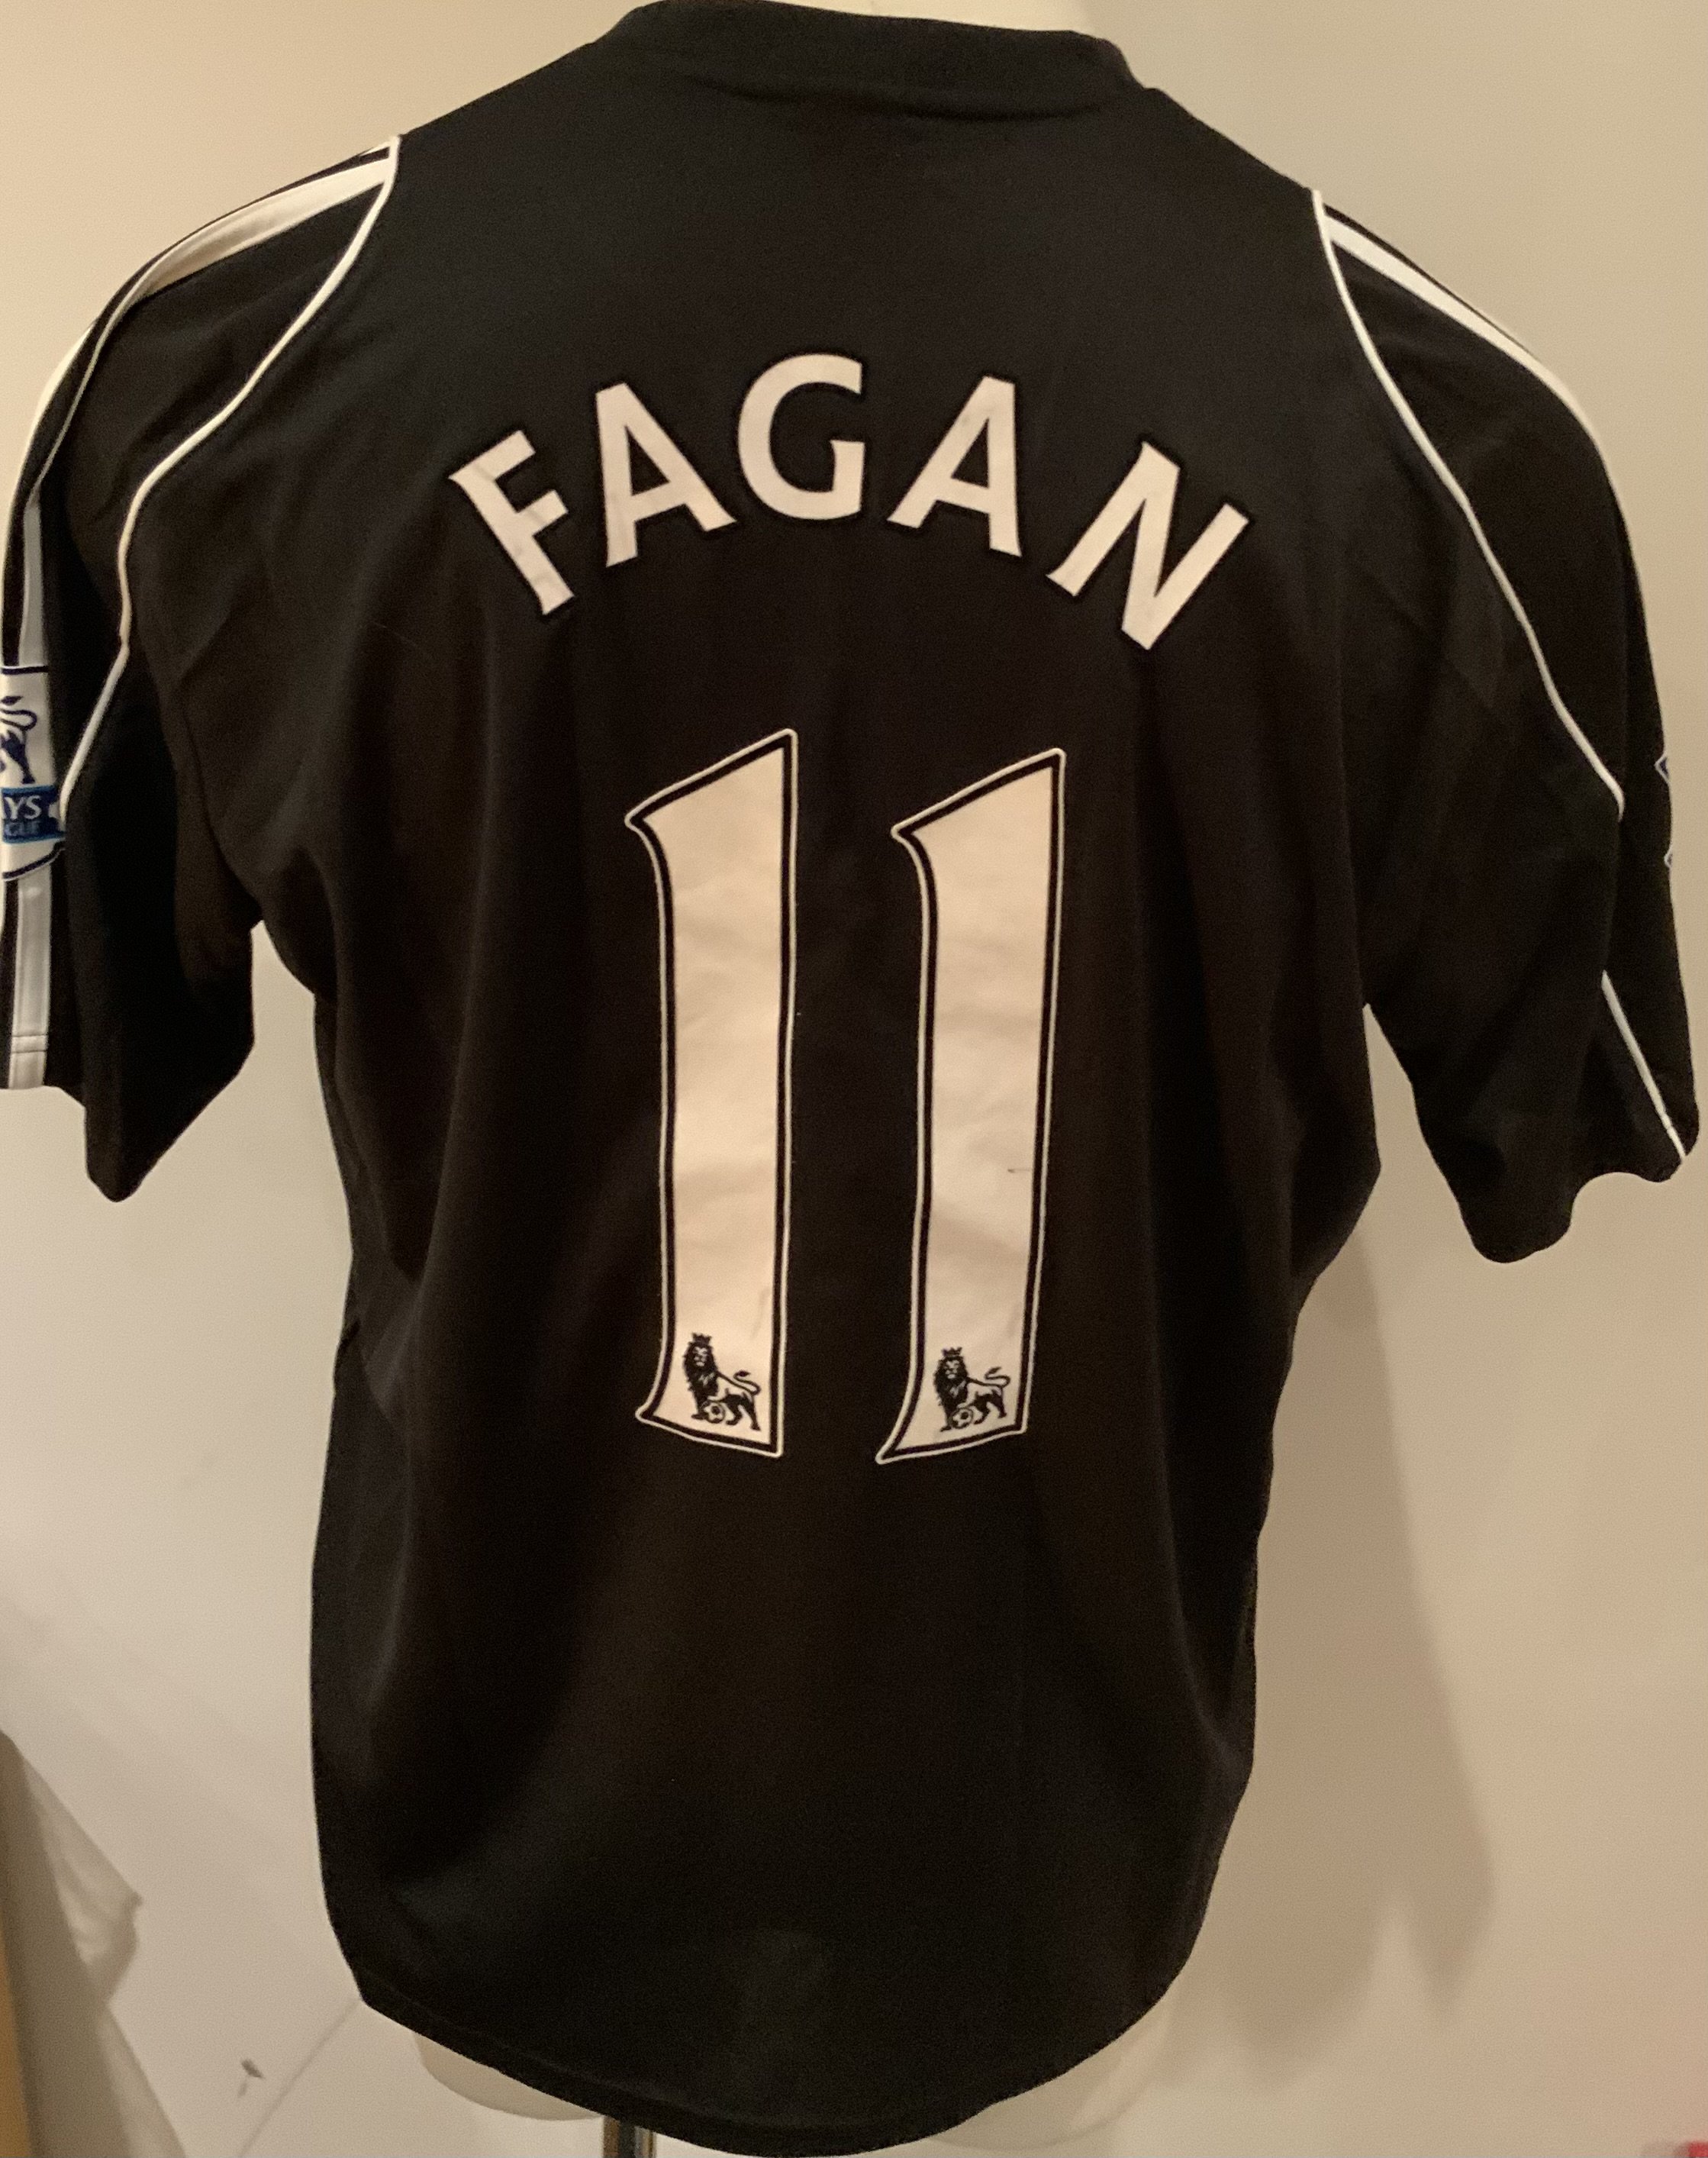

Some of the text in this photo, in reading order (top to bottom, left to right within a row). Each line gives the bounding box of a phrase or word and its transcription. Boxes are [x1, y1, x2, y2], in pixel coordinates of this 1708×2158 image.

[449, 353, 1249, 650] FAGAN
[0, 794, 41, 820] YS
[624, 728, 1066, 1465] 11
